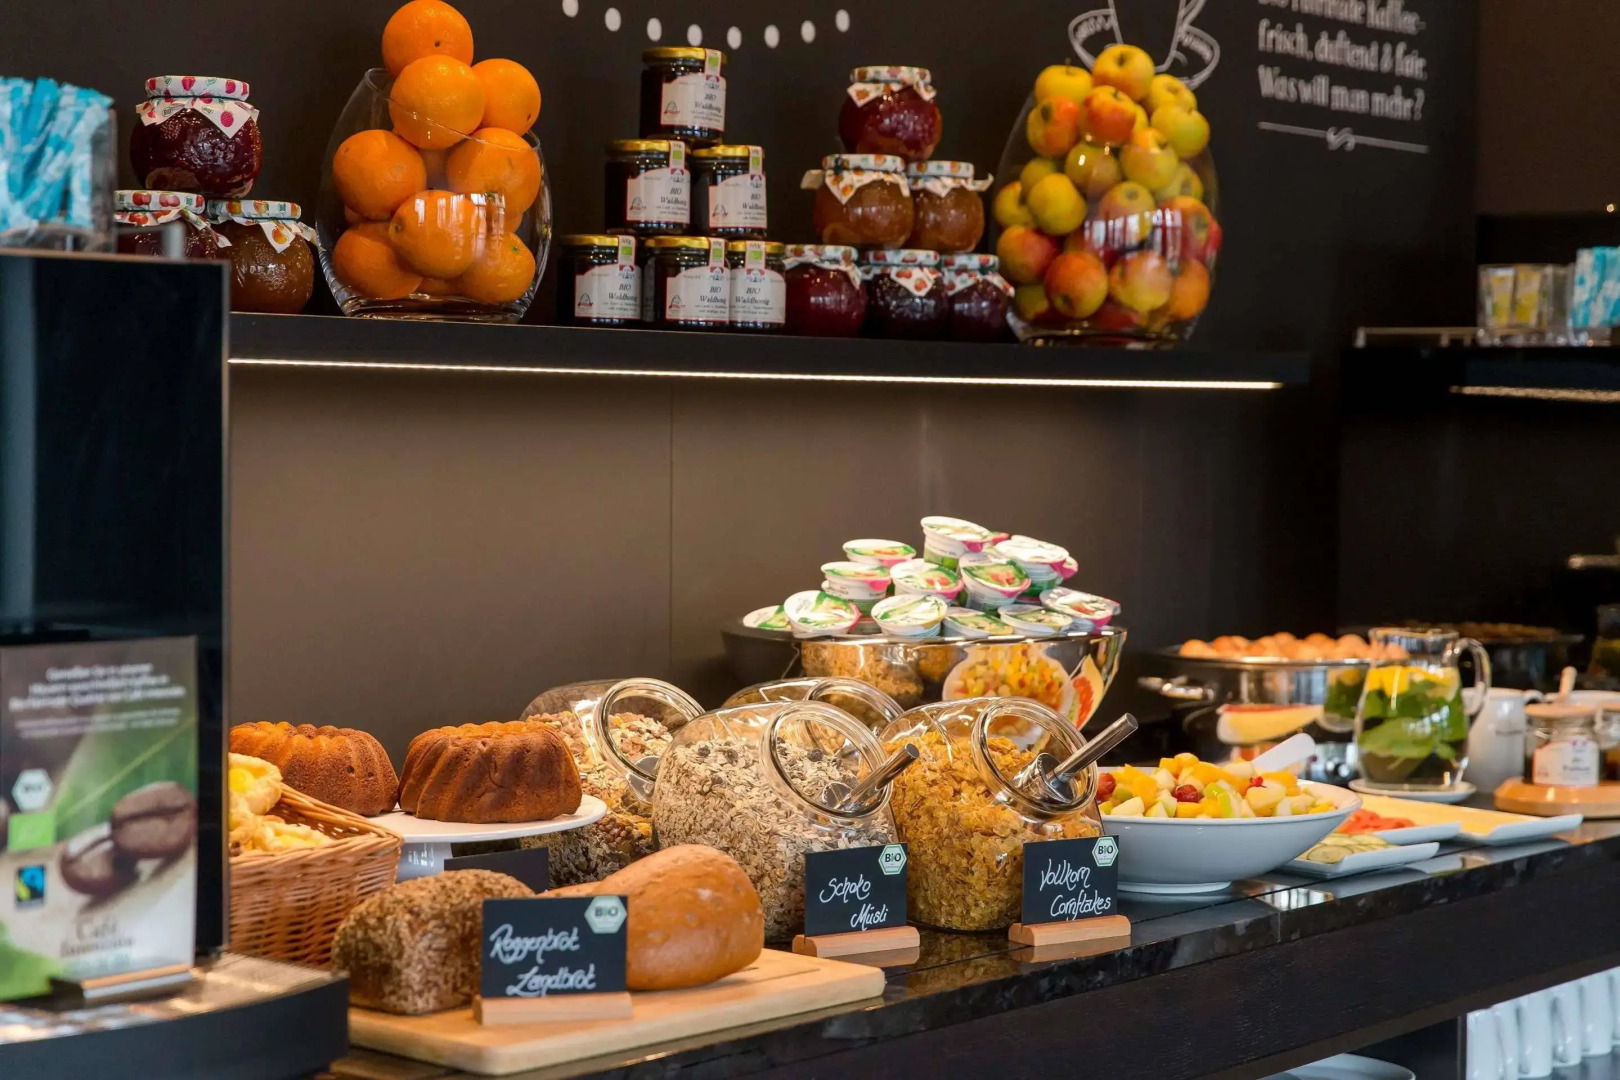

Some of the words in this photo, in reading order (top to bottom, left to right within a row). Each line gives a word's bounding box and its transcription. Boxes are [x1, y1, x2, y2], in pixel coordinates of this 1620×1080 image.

[1257, 64, 1298, 103] Was
[1298, 74, 1330, 107] will
[819, 873, 872, 904] Schoko
[1050, 889, 1112, 922] Cornflakes
[850, 903, 889, 932] Müsli
[489, 923, 580, 965] Roggenbrot
[505, 963, 596, 998] Landbrot
